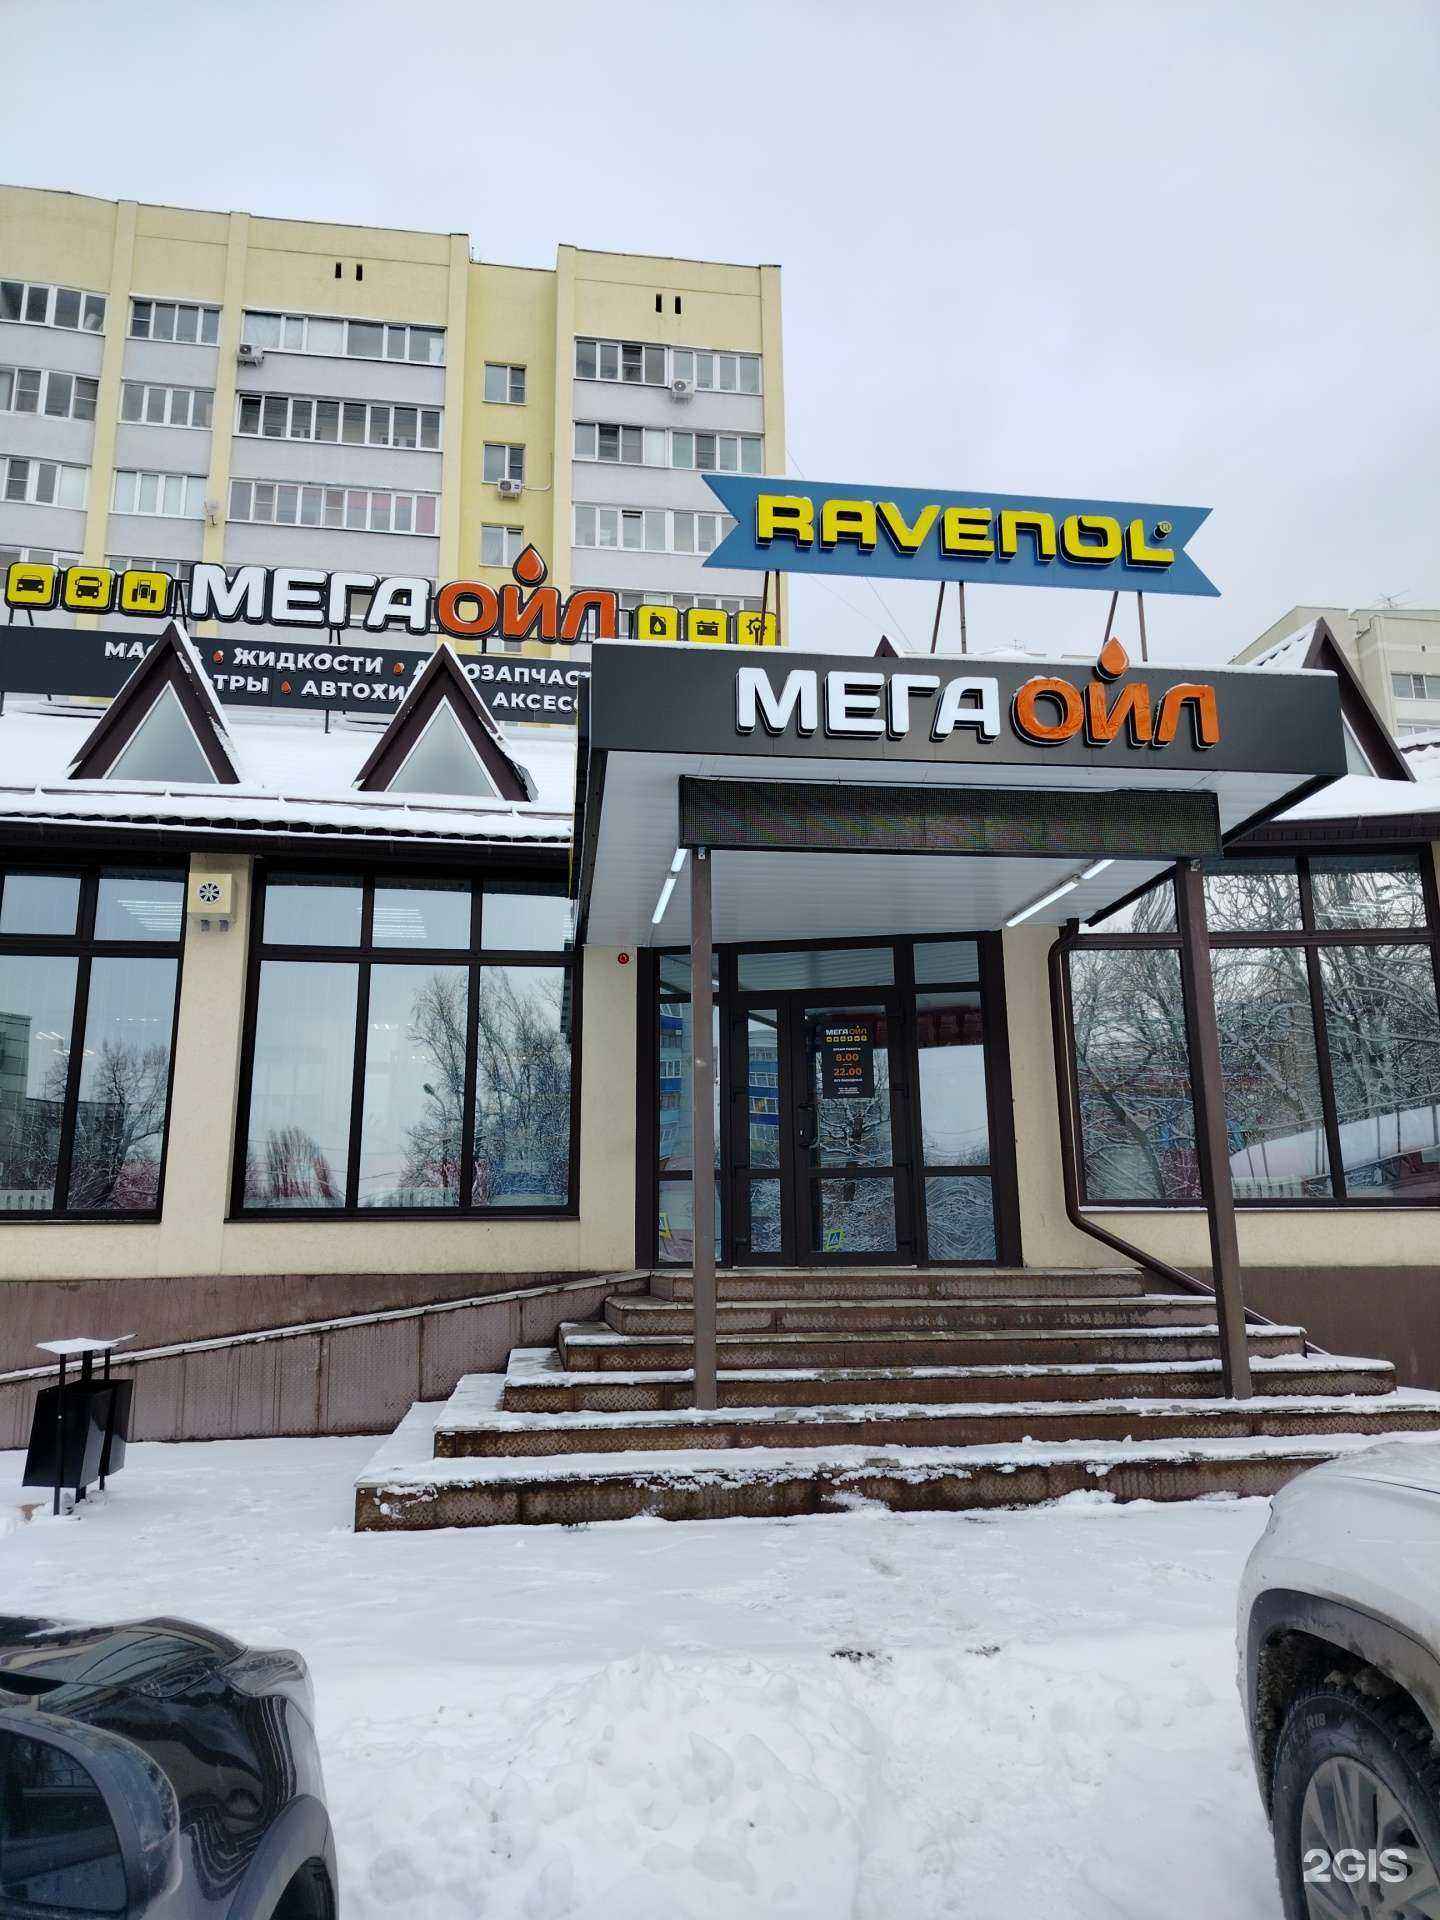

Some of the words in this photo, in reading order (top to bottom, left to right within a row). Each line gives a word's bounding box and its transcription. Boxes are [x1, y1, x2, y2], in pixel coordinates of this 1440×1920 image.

[756, 493, 1175, 568] RAVENOL
[232, 647, 384, 676] ЖИДКОСТИ
[300, 680, 410, 702] АВТОХИ
[833, 1067, 862, 1077] 22.00
